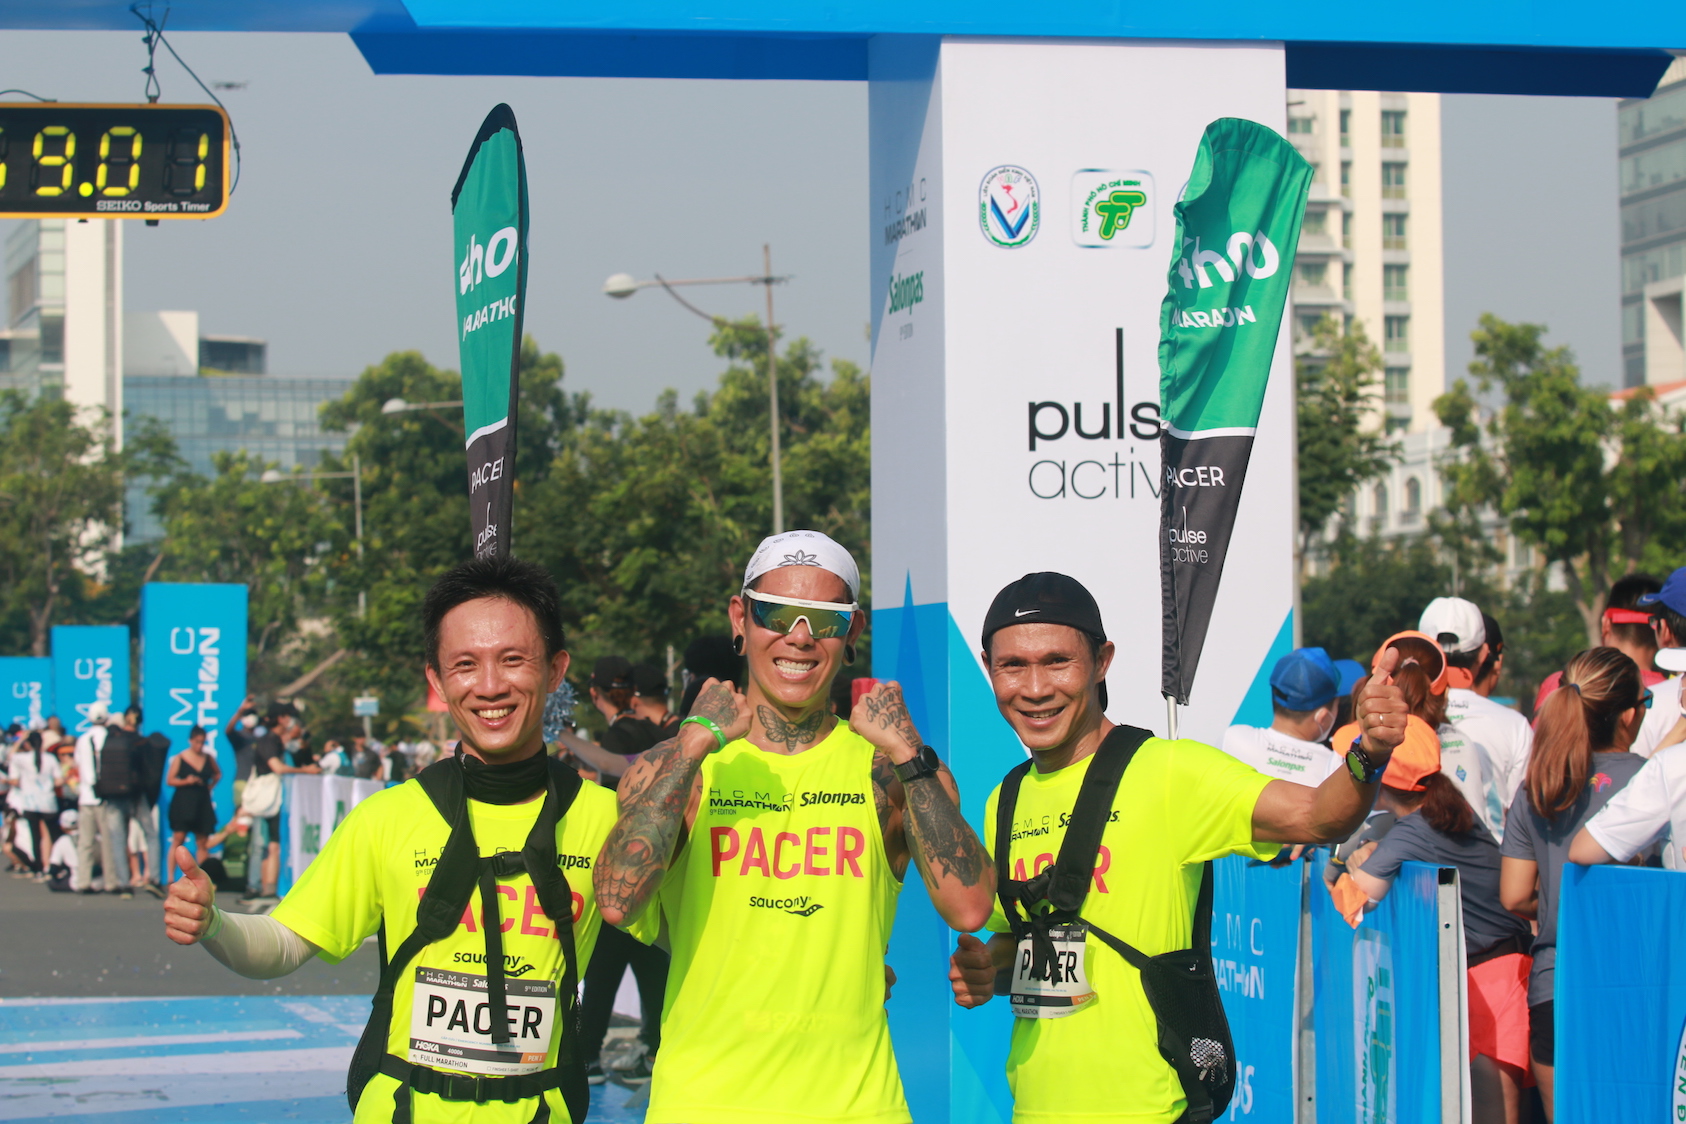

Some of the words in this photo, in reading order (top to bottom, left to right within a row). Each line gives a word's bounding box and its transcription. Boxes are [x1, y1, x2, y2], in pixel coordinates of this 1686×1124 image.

[0, 126, 208, 197] 9.01
[96, 201, 141, 212] SEIKO
[144, 201, 178, 212] Sports
[181, 201, 210, 211] Timer
[889, 271, 924, 315] Salonpas
[1029, 328, 1161, 452] puls
[1029, 447, 1161, 499] activ
[1166, 466, 1226, 488] PACER
[1169, 506, 1208, 544] pulse
[1267, 757, 1306, 772] Salonpas
[800, 791, 866, 806] Salonpas
[1012, 815, 1050, 832] CMC
[1010, 826, 1049, 843] RATHON
[710, 826, 865, 880] PACER
[749, 896, 808, 909] saucony
[415, 1040, 440, 1052] HOKA
[420, 1054, 434, 1063] FULL
[436, 1057, 468, 1068] MARATHON
